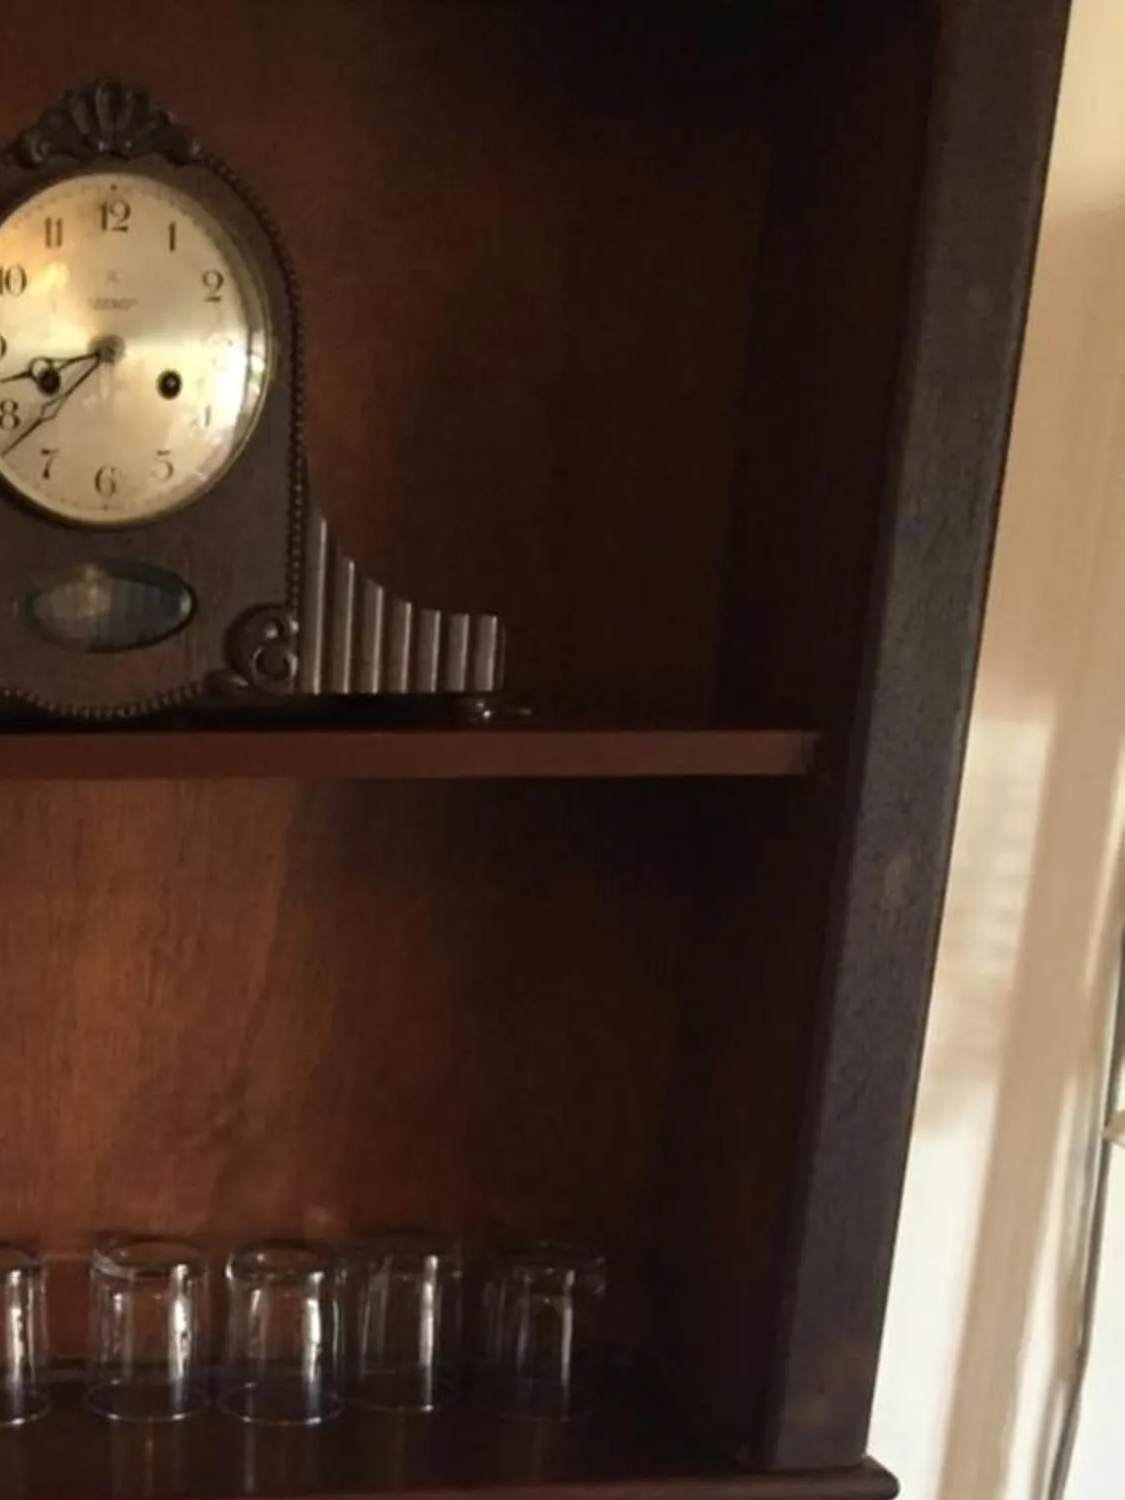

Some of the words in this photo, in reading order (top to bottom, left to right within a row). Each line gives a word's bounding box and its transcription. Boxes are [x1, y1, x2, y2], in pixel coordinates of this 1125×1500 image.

[44, 217, 64, 249] 11
[97, 200, 131, 233] 12
[167, 221, 177, 252] 1
[201, 269, 224, 302] 2
[39, 447, 61, 480] 7
[155, 449, 175, 482] 5
[93, 465, 118, 497] 6
